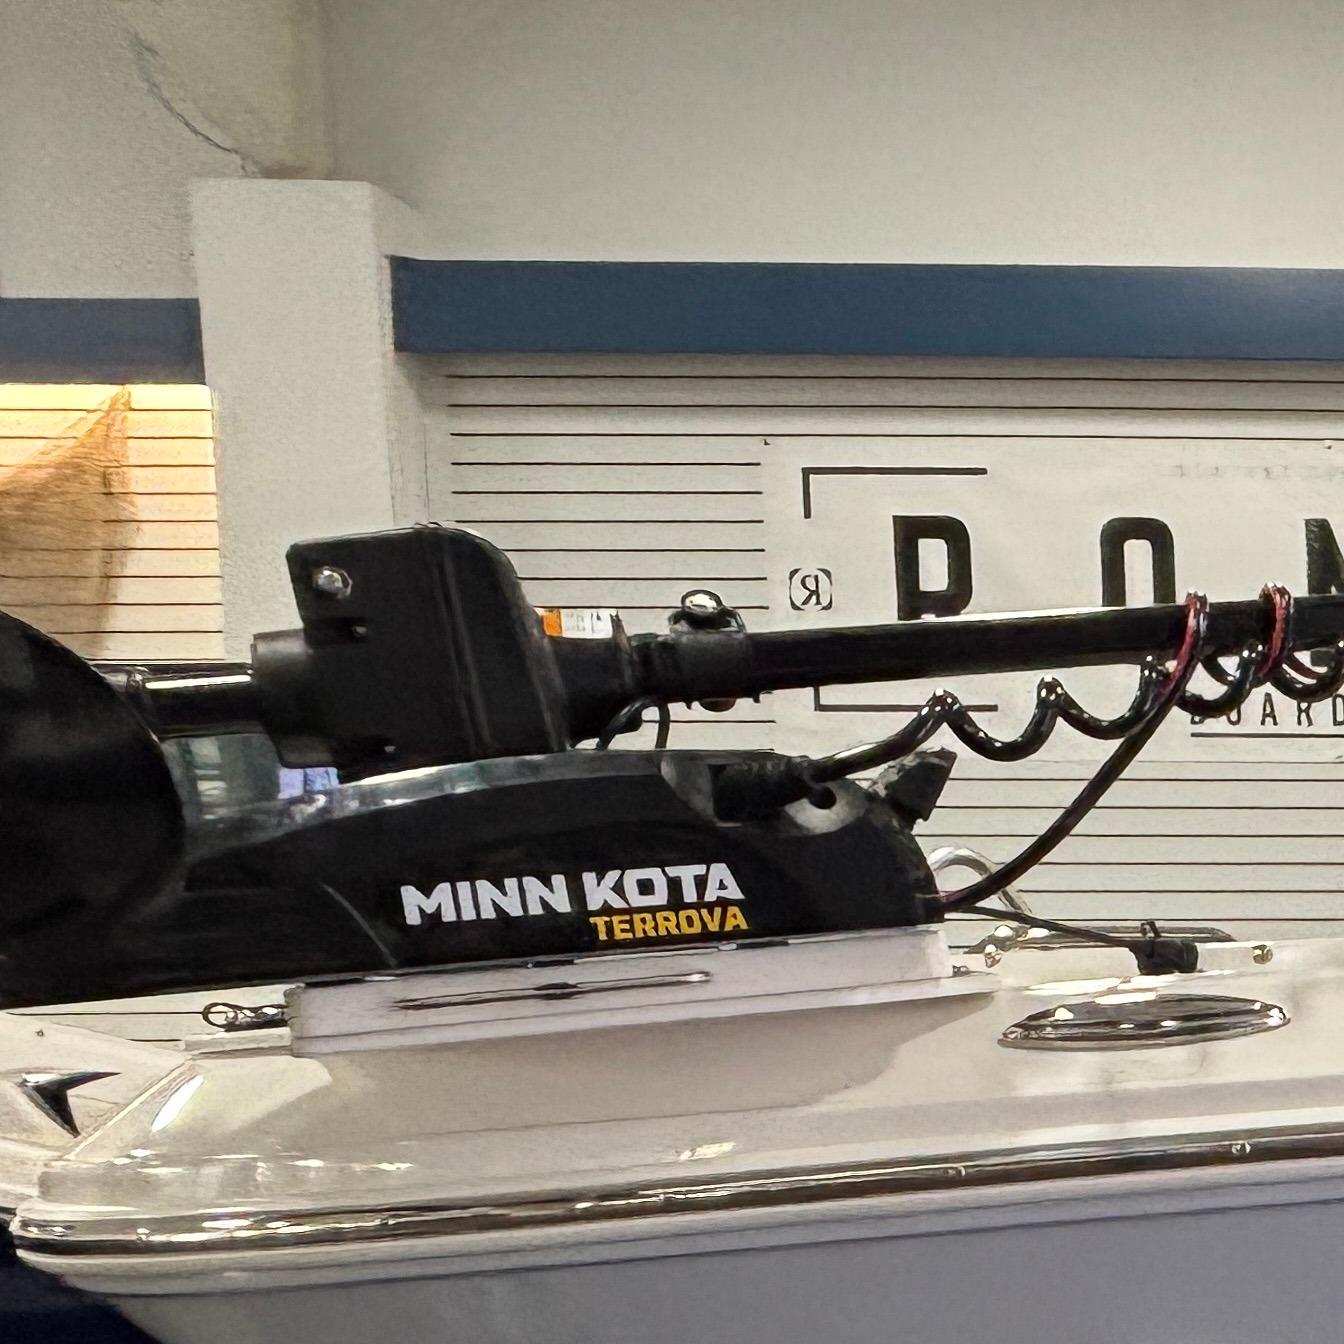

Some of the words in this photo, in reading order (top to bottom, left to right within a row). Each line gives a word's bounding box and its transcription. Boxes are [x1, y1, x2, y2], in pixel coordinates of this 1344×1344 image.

[400, 873, 572, 926] MINN
[581, 862, 746, 911] KOTA
[588, 905, 749, 941] TERROVA
